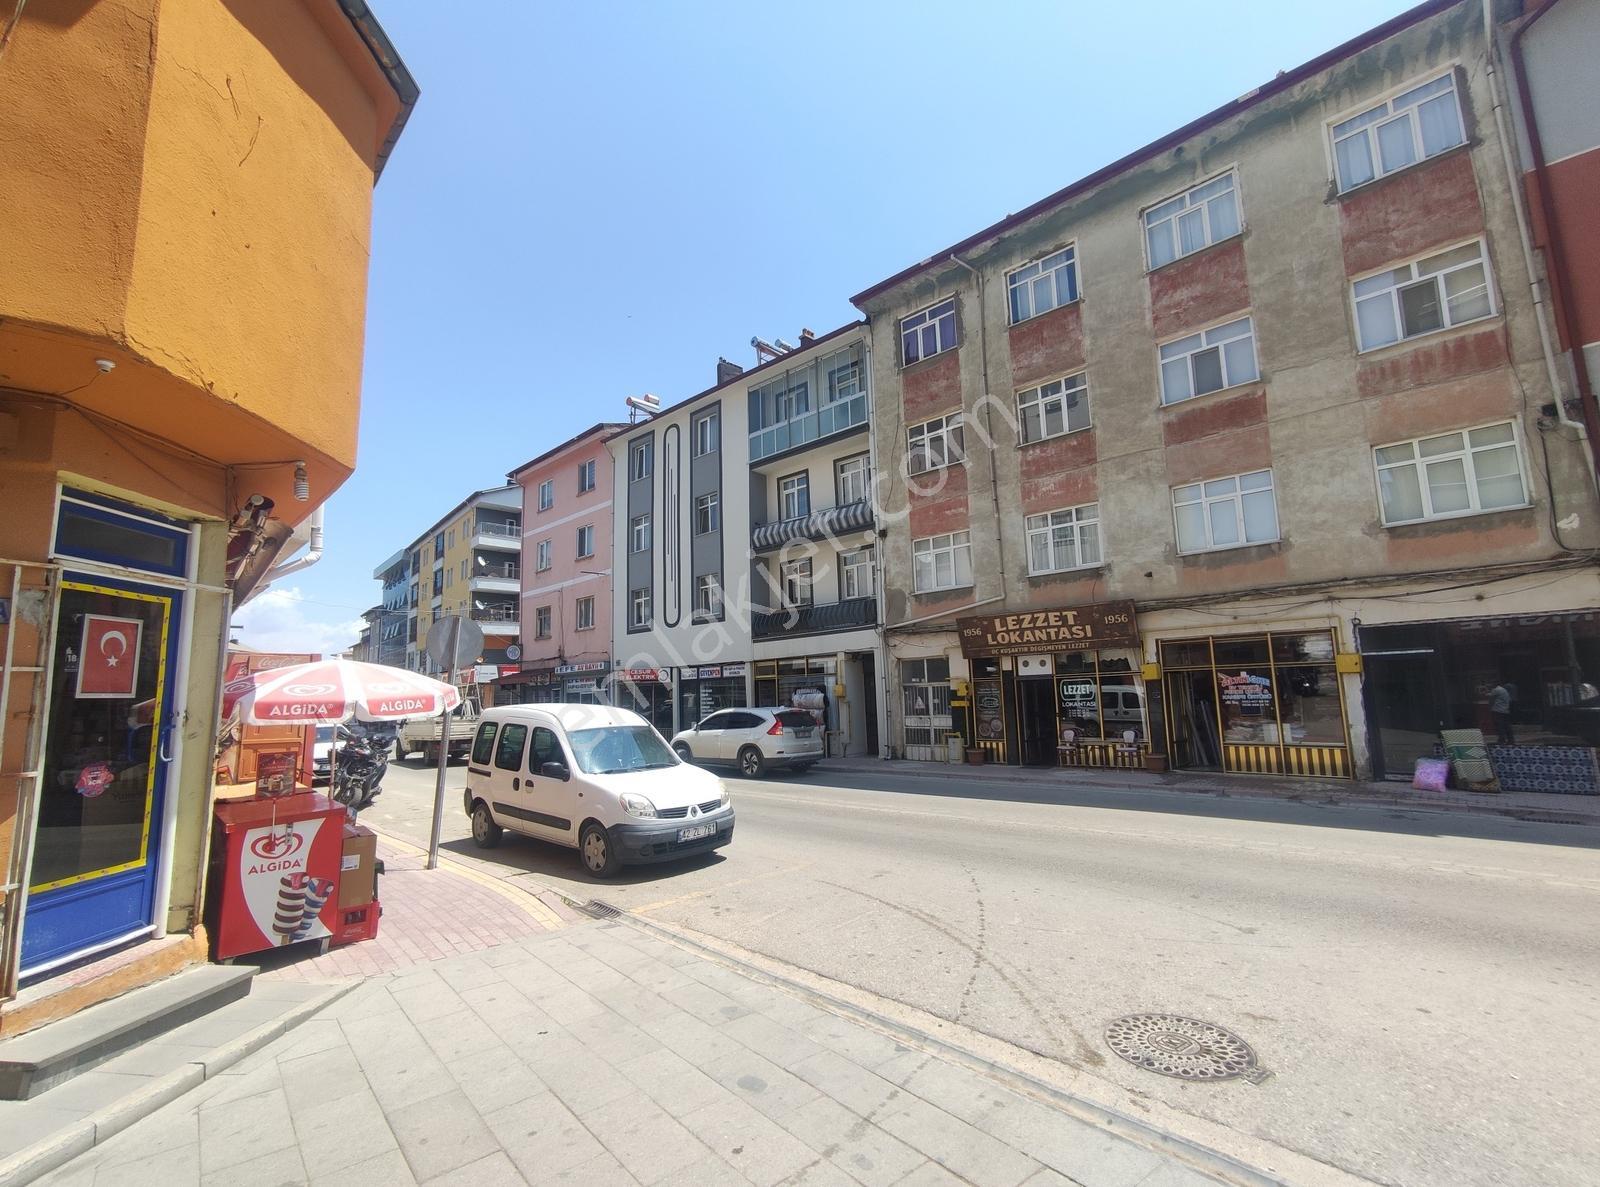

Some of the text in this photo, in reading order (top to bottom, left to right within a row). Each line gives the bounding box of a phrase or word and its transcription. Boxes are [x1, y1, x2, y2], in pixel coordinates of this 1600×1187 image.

[994, 611, 1078, 632] LEZZET
[1104, 614, 1129, 625] 1956
[963, 628, 982, 637] 1956
[987, 624, 1092, 645] LOKANTASI
[1063, 684, 1090, 695] LEZZET
